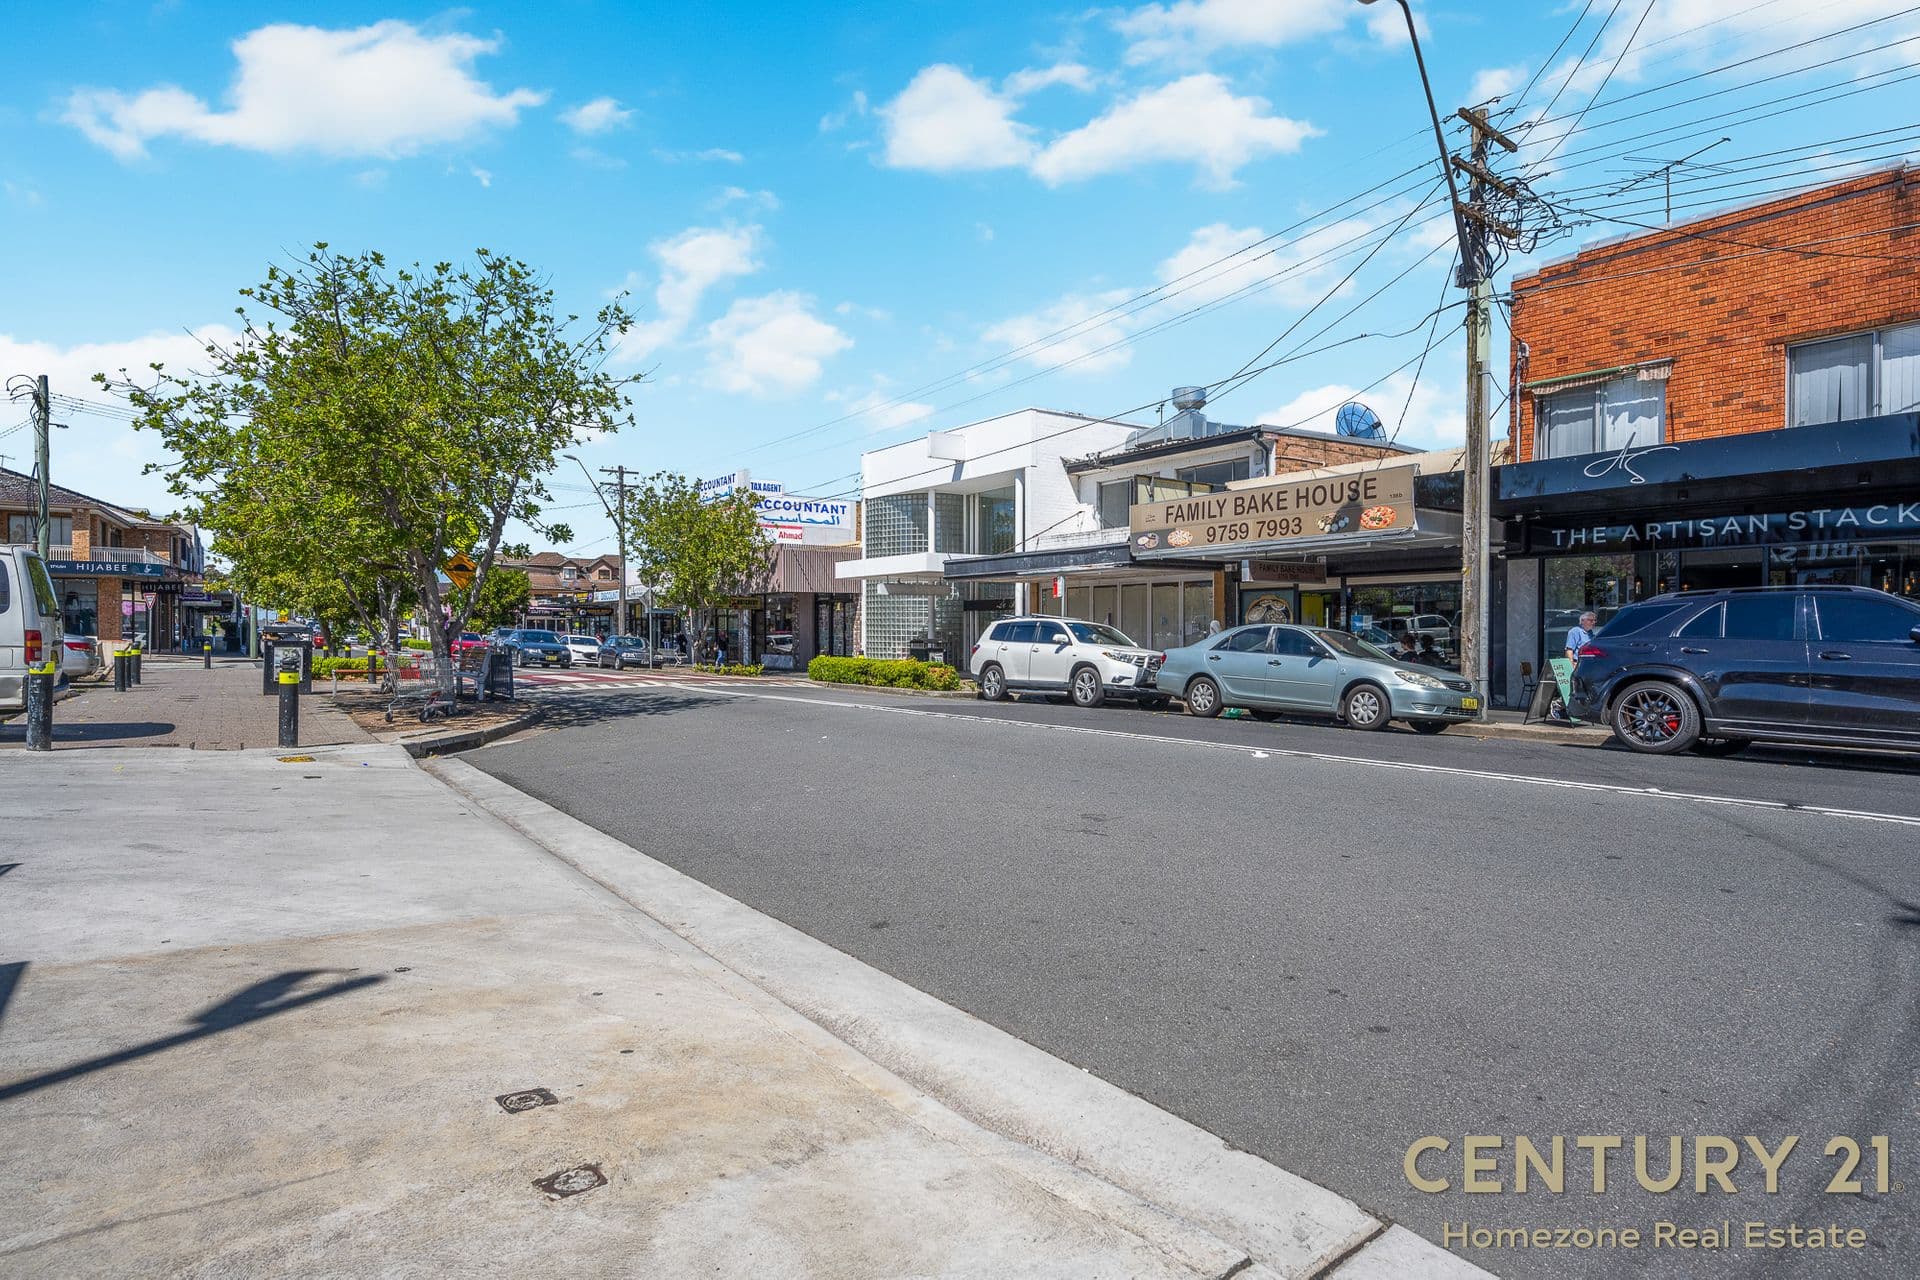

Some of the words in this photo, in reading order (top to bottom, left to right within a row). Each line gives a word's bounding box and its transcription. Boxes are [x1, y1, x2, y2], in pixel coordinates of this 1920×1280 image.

[751, 482, 762, 491] TAX
[763, 483, 782, 493] AGENT
[755, 499, 847, 515] ACCOUNTANT
[1166, 498, 1228, 524] FAMILY
[1234, 490, 1288, 515] BAKE
[1296, 477, 1377, 508] HOUSE
[762, 514, 841, 526] المحاسب
[1552, 526, 1607, 546] THE
[1622, 513, 1769, 543] ARTISAN
[1789, 502, 1920, 531] STACK
[778, 530, 803, 541] Ahmad
[1206, 523, 1250, 543] 9759
[1256, 517, 1303, 538] 7993
[76, 563, 128, 572] HIJABEE
